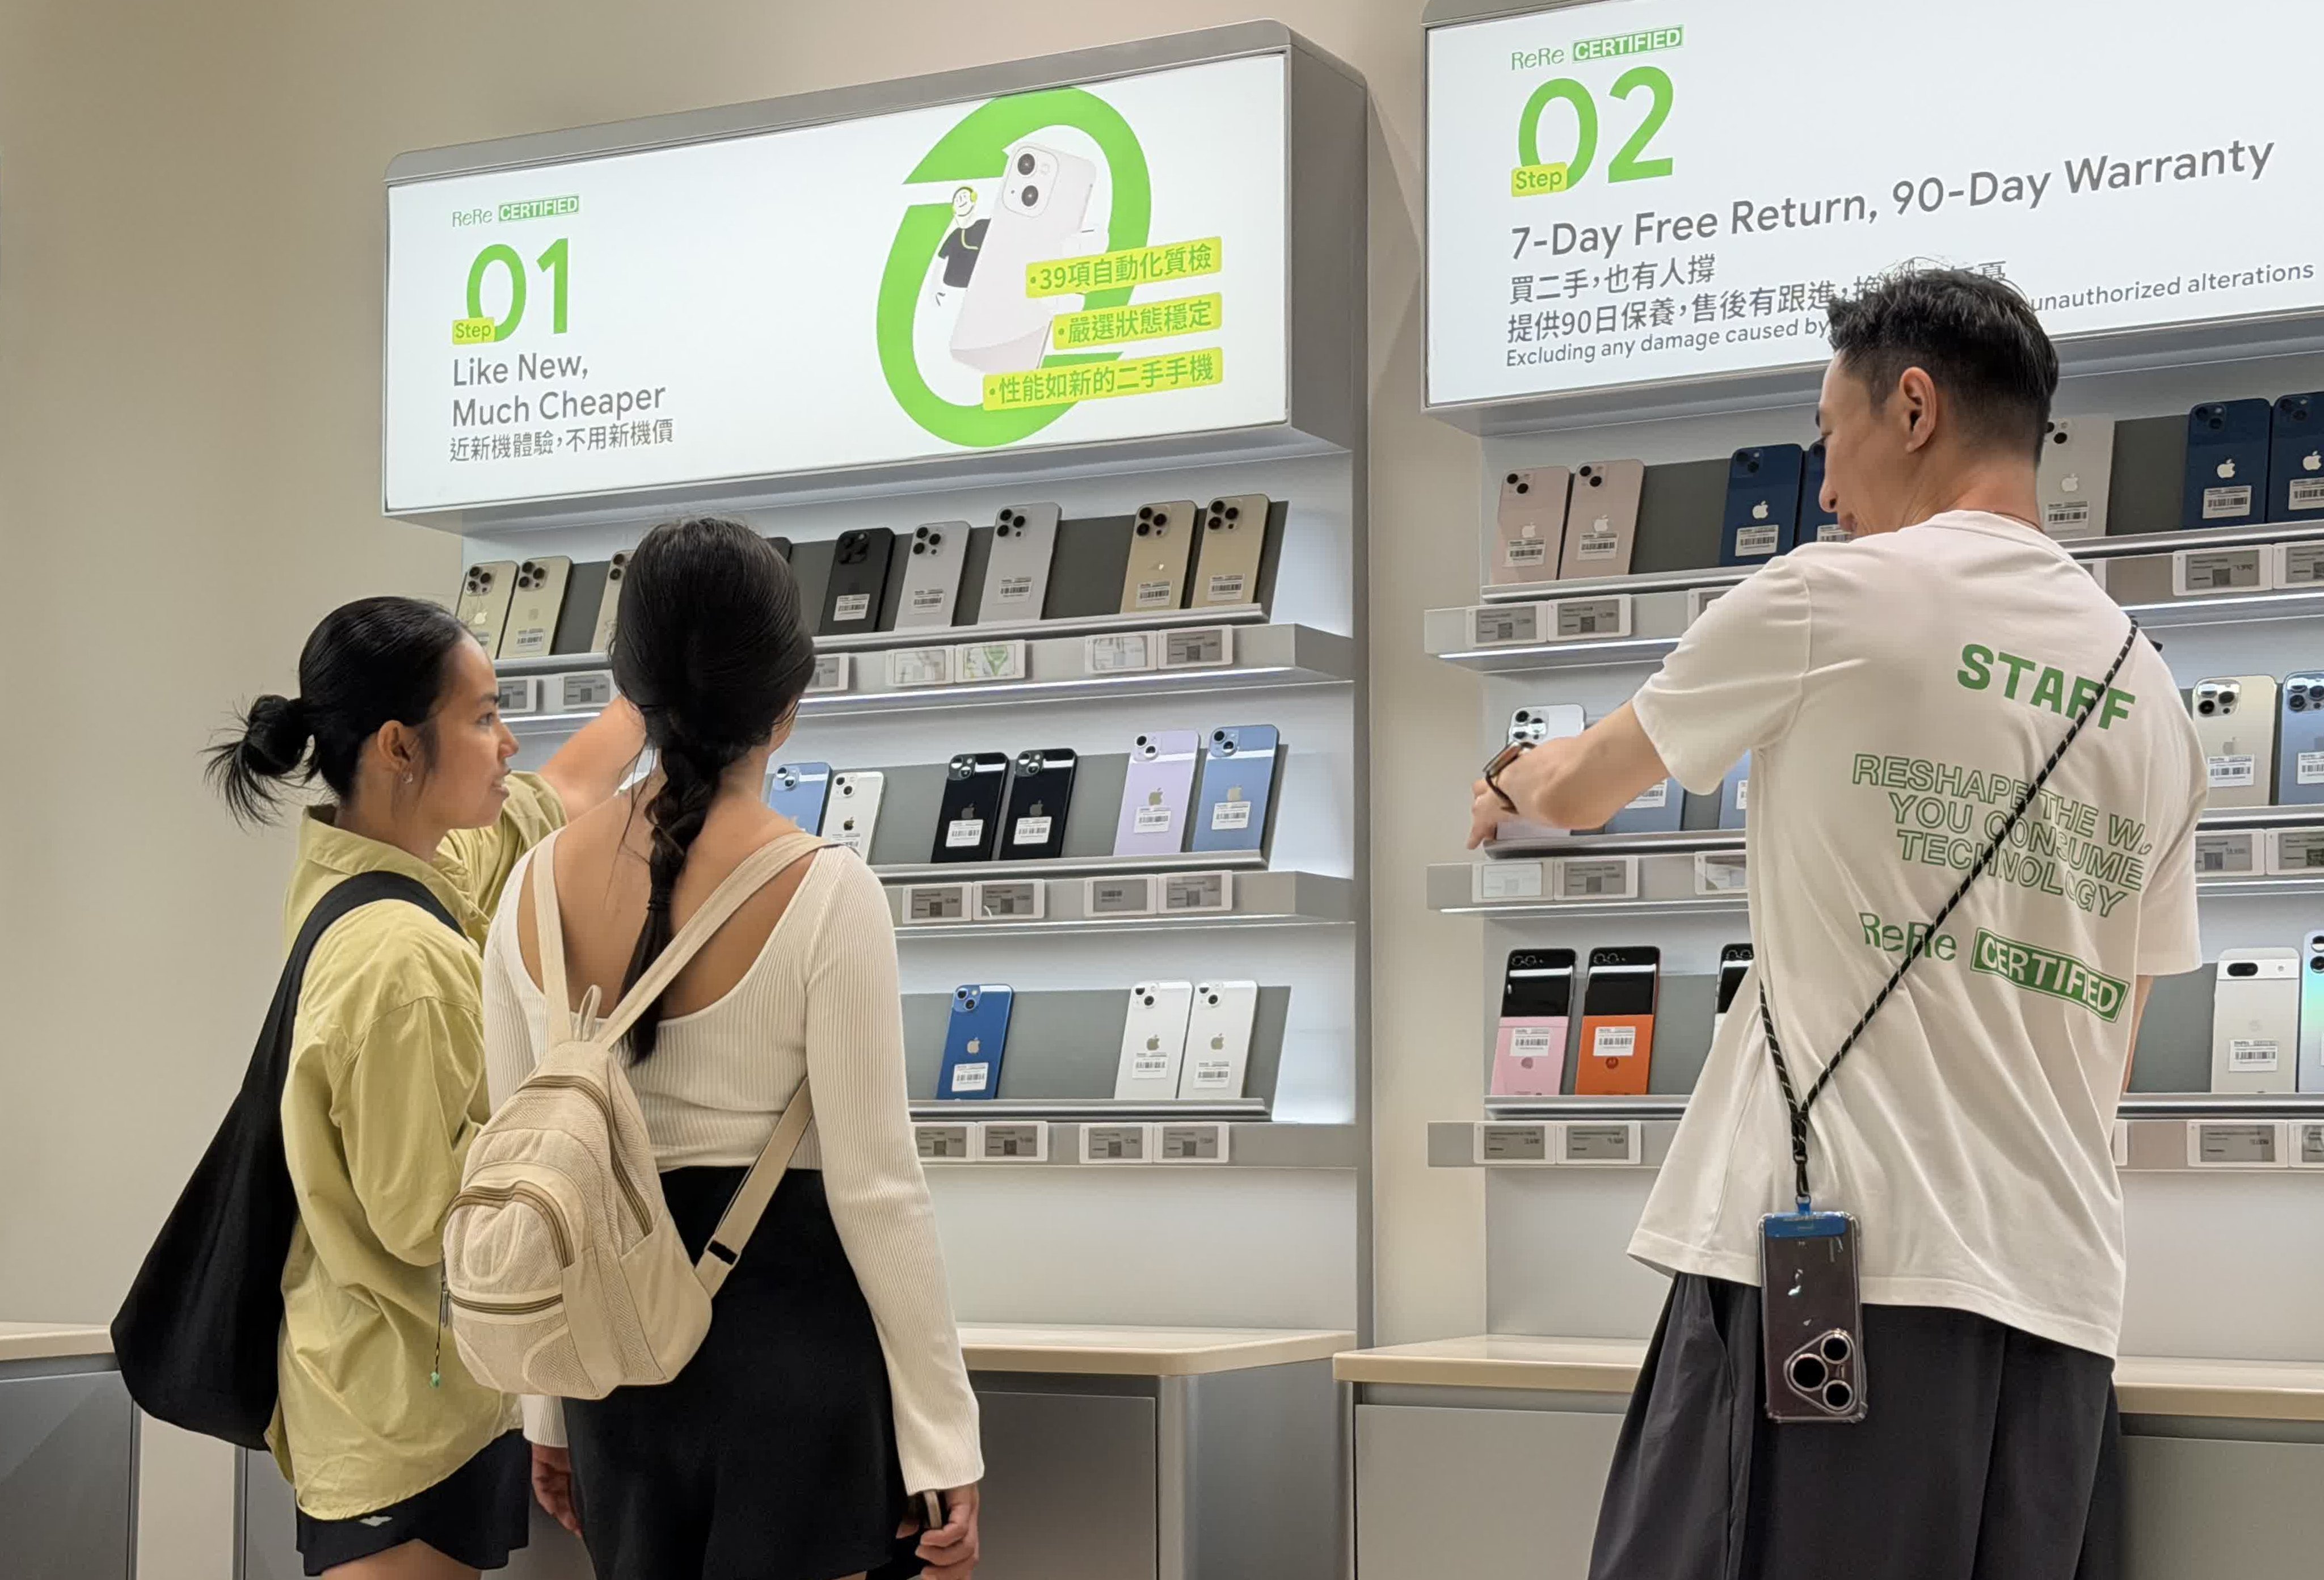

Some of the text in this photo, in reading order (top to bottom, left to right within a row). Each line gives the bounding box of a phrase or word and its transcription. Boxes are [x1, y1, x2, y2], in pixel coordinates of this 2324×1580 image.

[1512, 29, 1681, 71] ReRe CERTIFIED
[1518, 65, 1674, 191] 02
[452, 197, 578, 227] ReRe CERTIFIED
[1511, 140, 2275, 260] 7-Day Free Return, 90-Day Warranty
[1515, 169, 1563, 193] Step
[466, 237, 569, 343] 01
[1067, 300, 1212, 344] 嚴選狀態穩定
[1506, 262, 2314, 367] Excluding any damage caused by unauthorized alterations
[454, 322, 492, 342] Step
[453, 352, 589, 386] Like New,
[998, 353, 1214, 404] 性能如新的二手手機
[452, 386, 666, 427] Much Cheaper
[1957, 643, 2136, 730] STAFF
[1852, 753, 2030, 810] RESHAPE
[2039, 787, 2099, 839] THE
[1888, 792, 2145, 892] YOU CONSUME
[1858, 912, 2119, 1013] ReRe CERTIFIED
